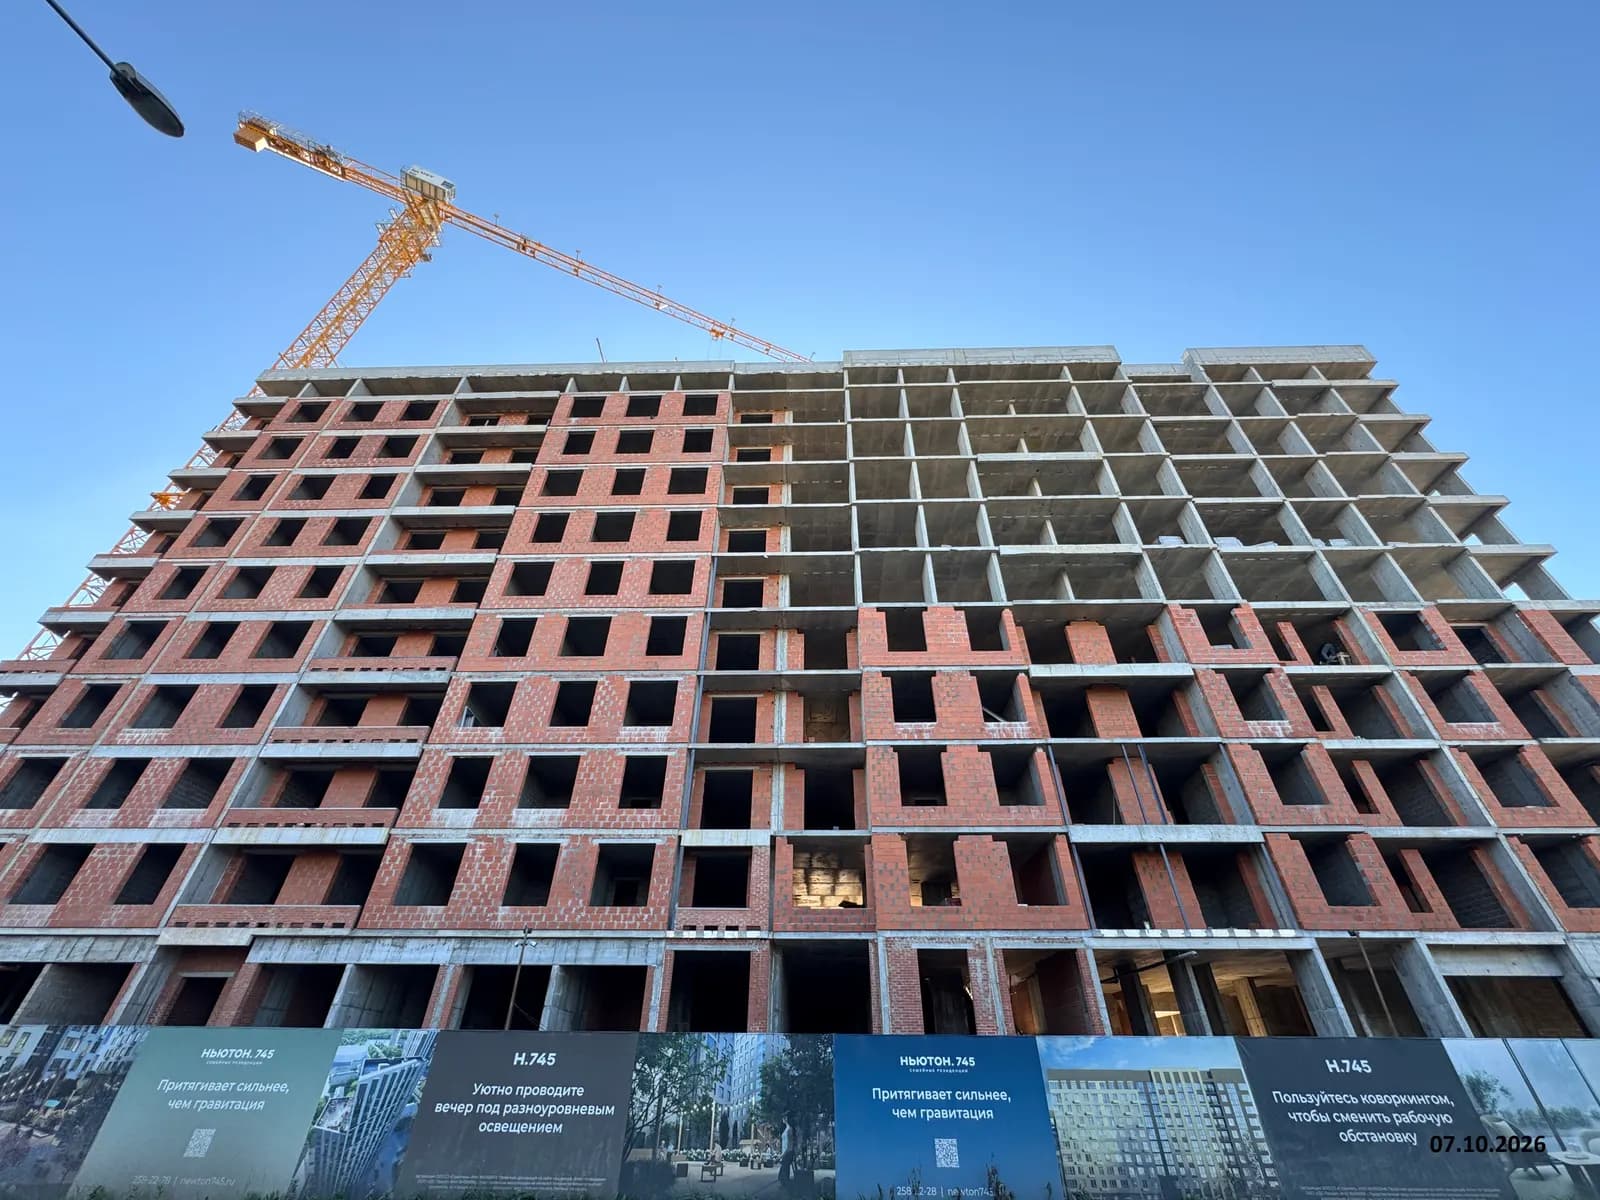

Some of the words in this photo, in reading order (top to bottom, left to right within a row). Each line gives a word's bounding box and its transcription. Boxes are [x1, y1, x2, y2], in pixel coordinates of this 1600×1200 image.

[513, 1052, 557, 1066] Н.745
[1325, 1059, 1373, 1073] Н.745
[157, 1079, 236, 1093] Притягивает
[236, 1082, 290, 1094] сильнее,
[472, 1083, 513, 1096] Уютно
[516, 1085, 585, 1098] проводите
[872, 1087, 952, 1102] Притягивает
[955, 1090, 1011, 1103] сильнее,
[1272, 1091, 1359, 1106] Пользуйтесь
[1359, 1094, 1455, 1107] коворкингом,
[168, 1099, 192, 1110] чем
[193, 1099, 265, 1112] гравитация
[435, 1102, 473, 1116] вечер
[476, 1103, 500, 1115] под
[502, 1103, 615, 1117] разноуровневым
[892, 1108, 917, 1119] чем
[920, 1108, 994, 1121] гравитация
[1288, 1109, 1331, 1123] чтобы
[1332, 1111, 1391, 1124] сменить
[1391, 1110, 1453, 1127] рабочую
[478, 1121, 563, 1134] освещением
[1339, 1128, 1418, 1145] обстановку
